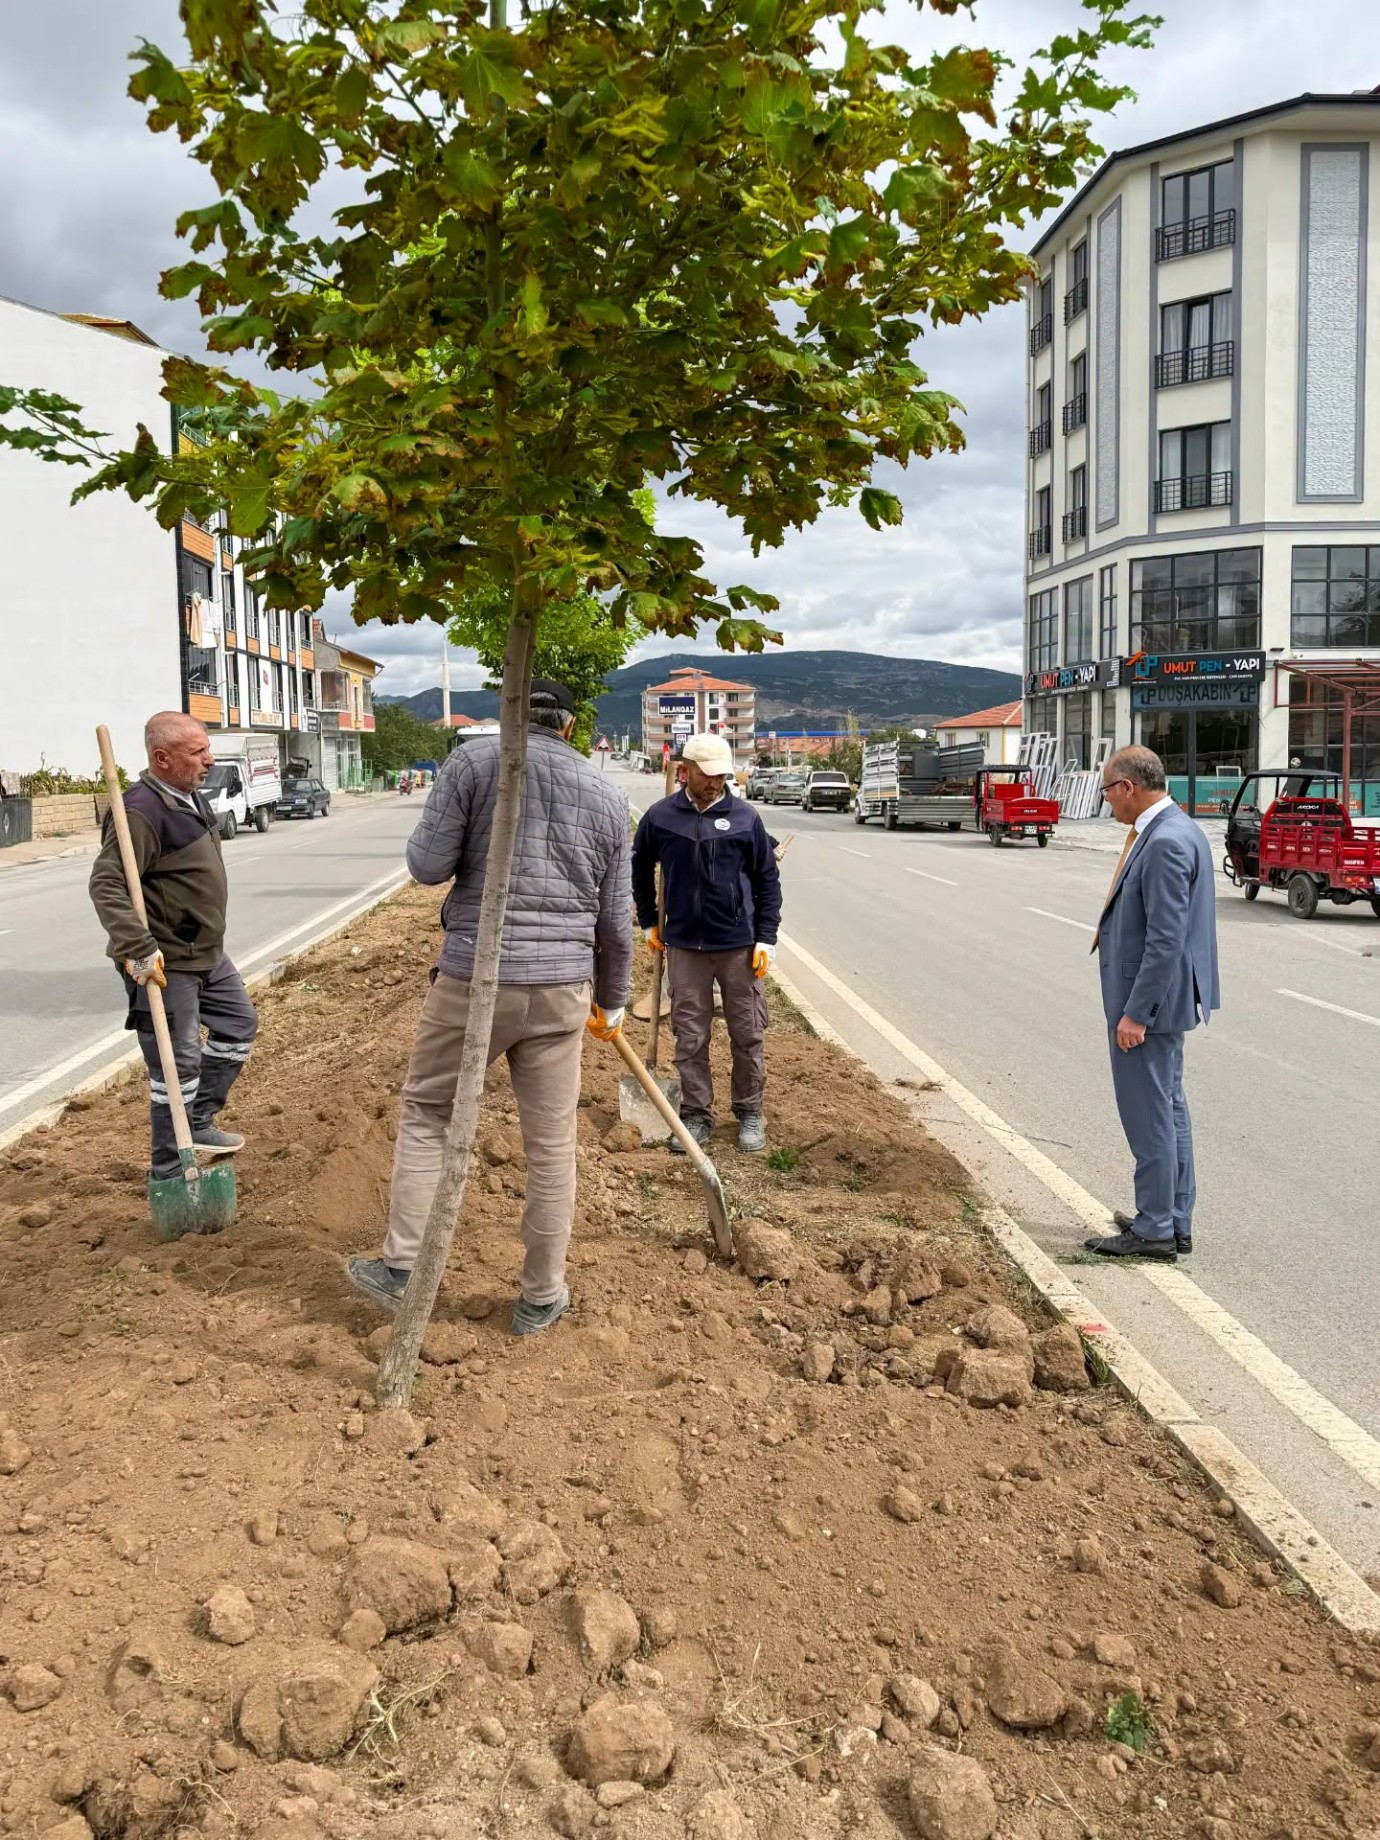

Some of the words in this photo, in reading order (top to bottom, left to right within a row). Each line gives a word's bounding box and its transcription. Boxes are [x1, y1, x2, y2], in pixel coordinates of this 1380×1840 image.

[1163, 661, 1196, 674] UMUT
[1199, 660, 1222, 673] PEN
[1233, 658, 1260, 671] YAPI
[1040, 672, 1059, 689] UMUT
[1060, 669, 1074, 687] PEN
[1080, 665, 1096, 684] YAPI
